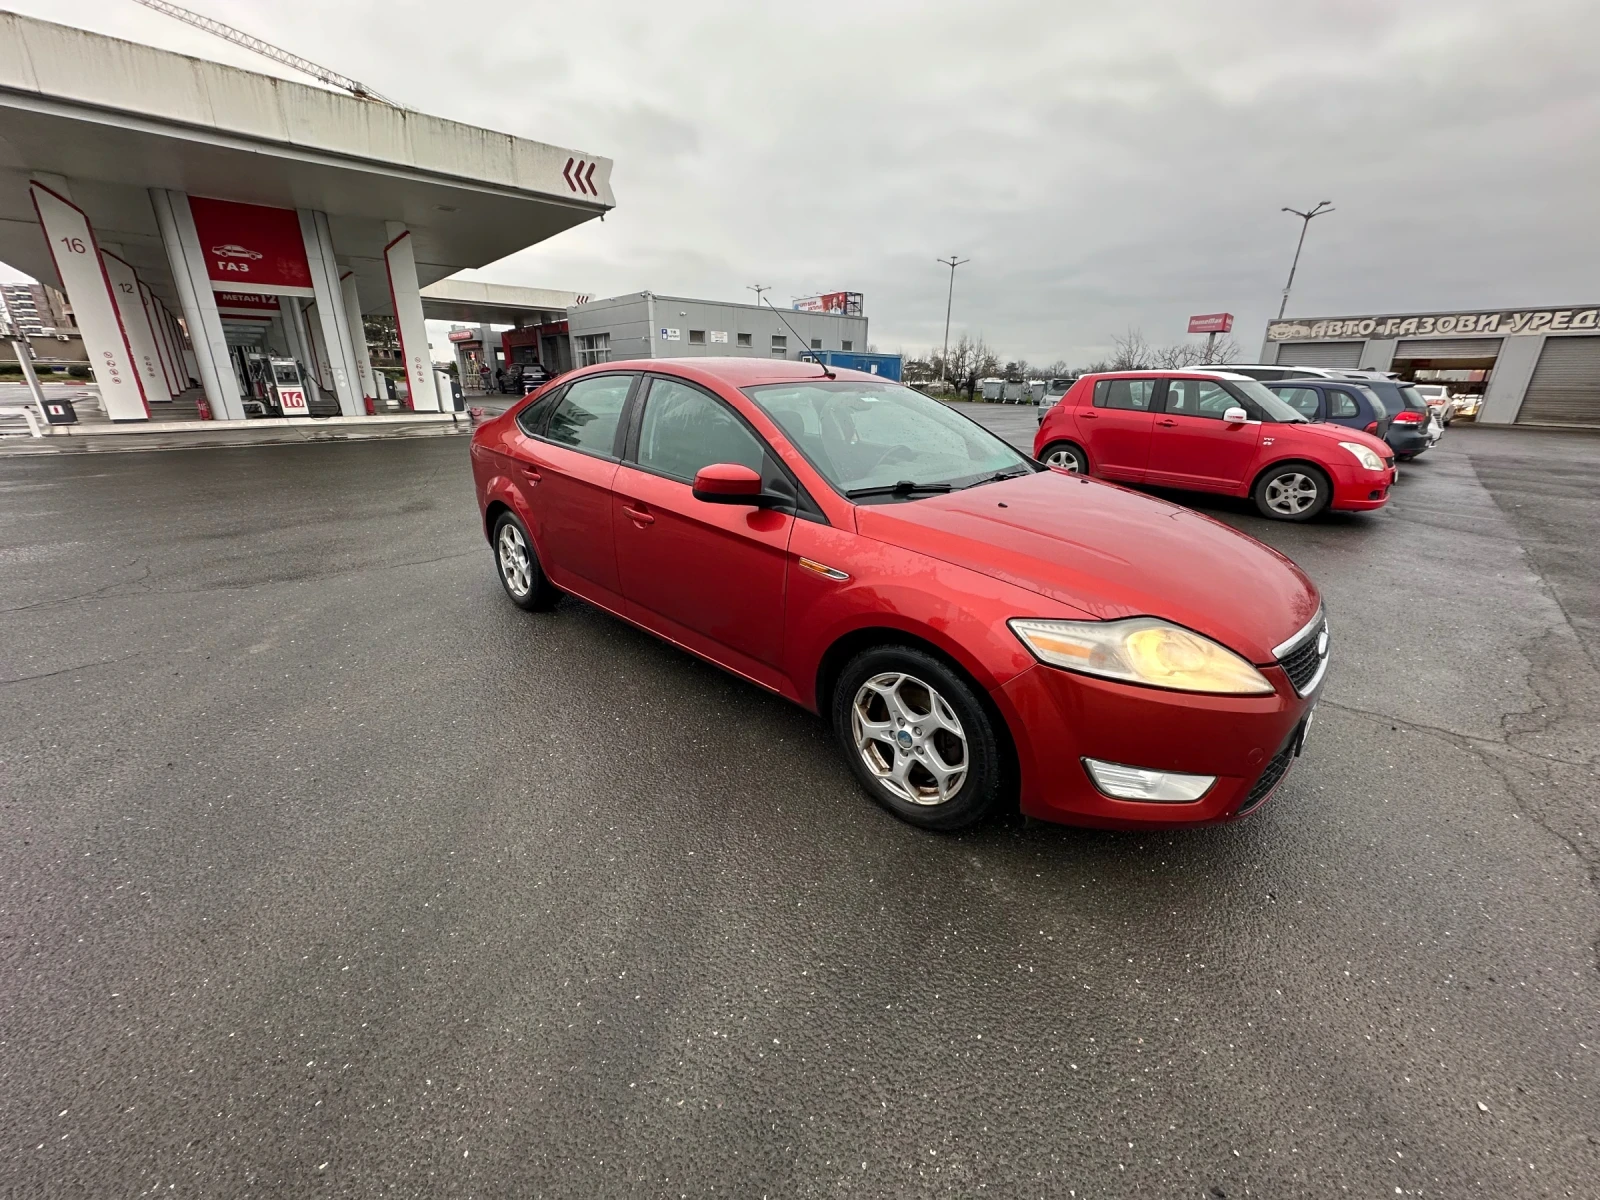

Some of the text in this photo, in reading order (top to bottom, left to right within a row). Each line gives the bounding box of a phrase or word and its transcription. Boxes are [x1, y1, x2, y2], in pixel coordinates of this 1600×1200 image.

[61, 237, 86, 254] 16
[217, 261, 250, 272] ГАЗ
[118, 283, 134, 294] 12
[222, 293, 277, 304] МЕТАН 12
[1311, 309, 1600, 338] АВТО ГАЗОВИ УРЕД
[283, 392, 303, 407] 16
